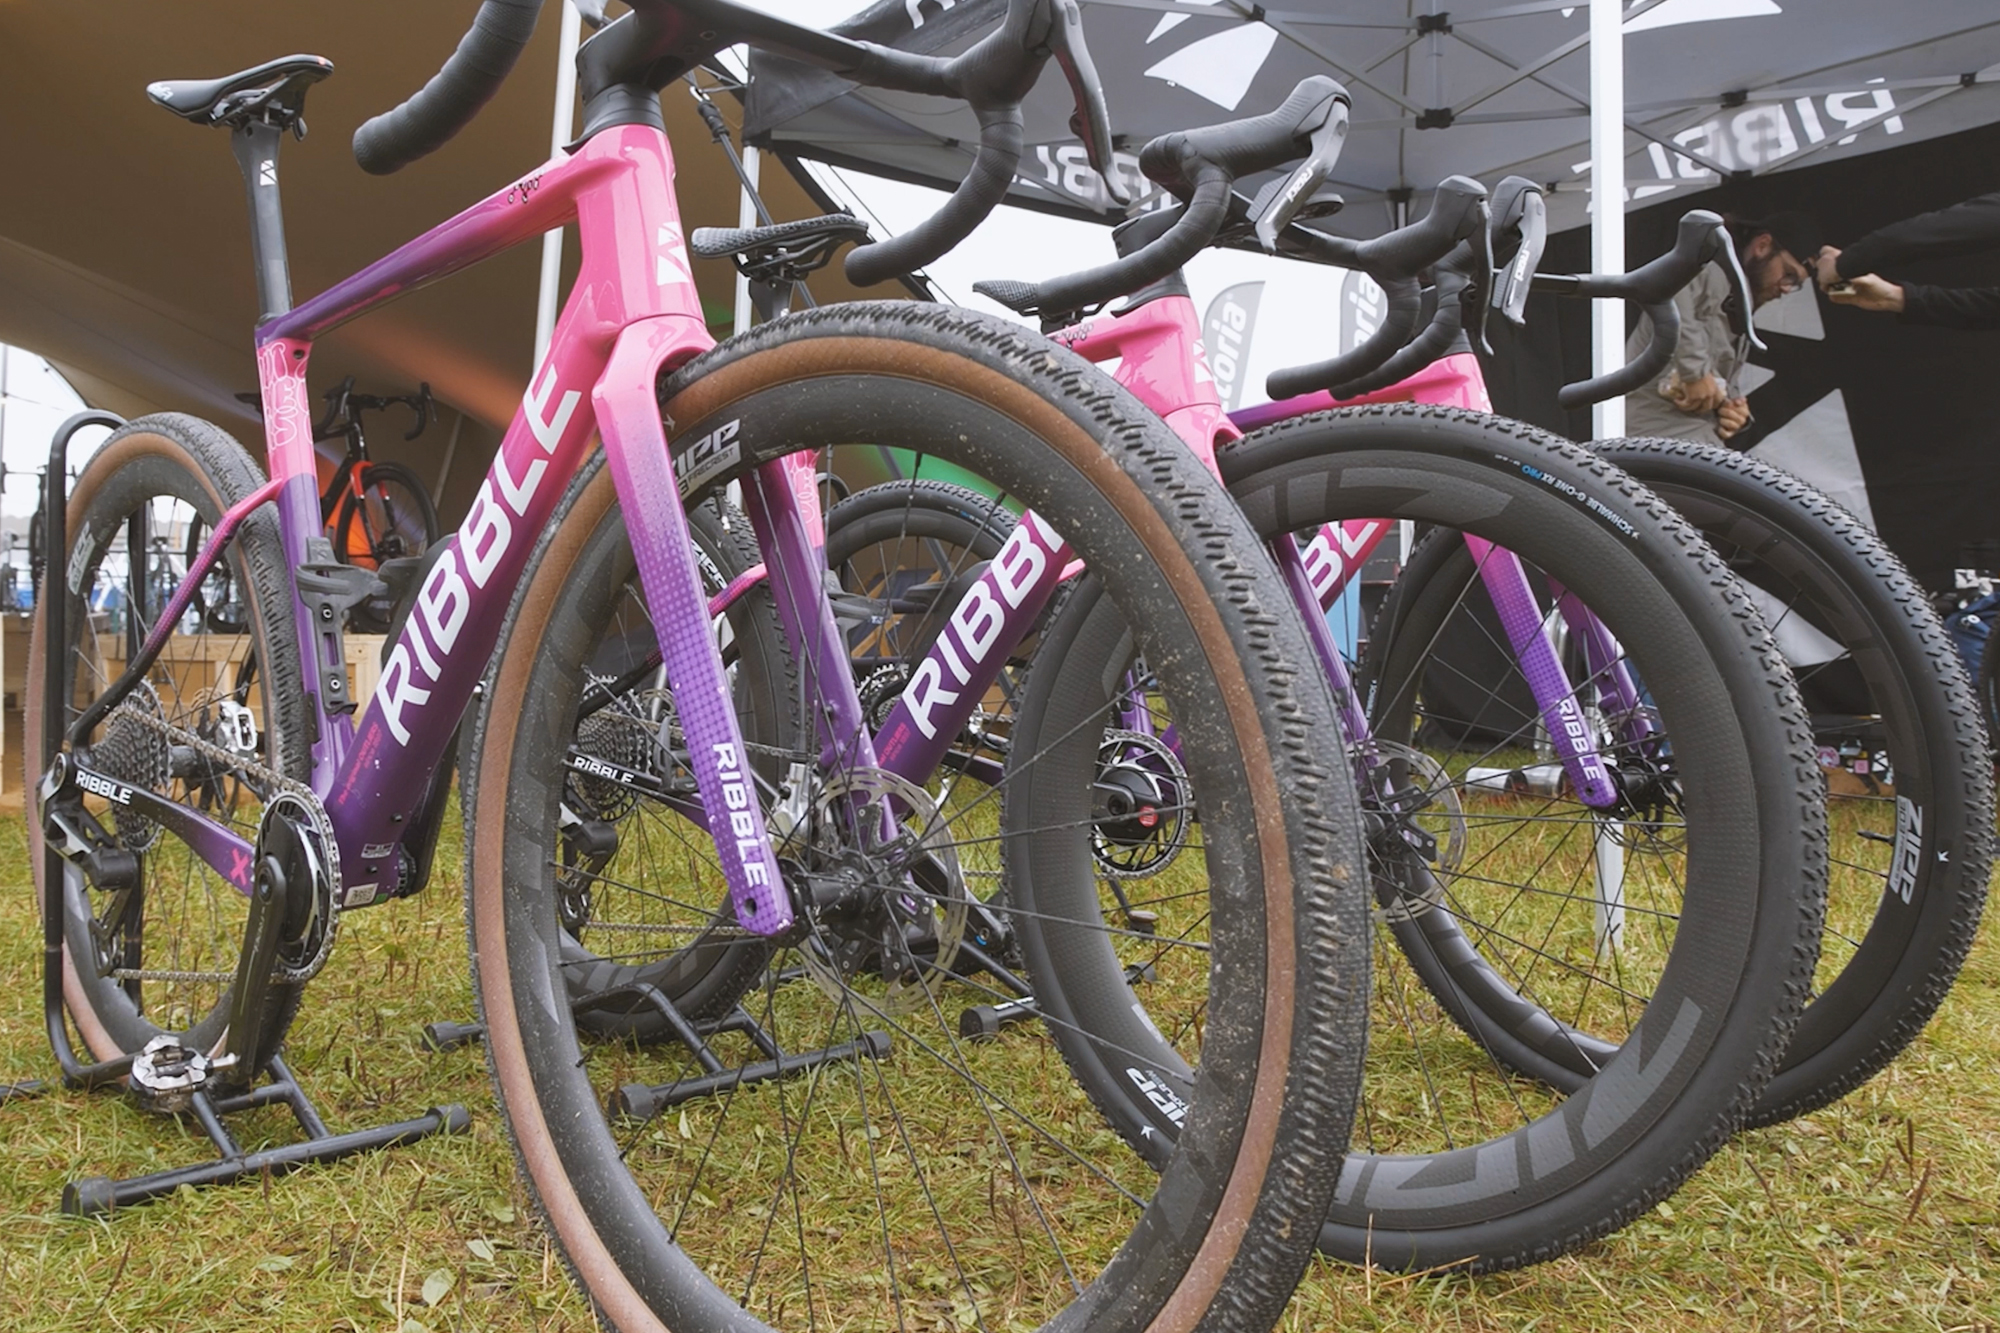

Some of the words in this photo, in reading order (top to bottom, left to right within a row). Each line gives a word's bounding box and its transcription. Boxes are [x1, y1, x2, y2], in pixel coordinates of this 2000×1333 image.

[672, 418, 740, 478] IPP
[1521, 464, 1543, 480] PRO
[1585, 496, 1635, 535] SCHWALBE
[376, 363, 582, 747] RIBBLE
[573, 756, 635, 783] RIBBLE
[1556, 698, 1602, 781] RIBBLE
[75, 769, 133, 805] RIBBLE
[712, 742, 769, 888] RIBBLE
[1901, 801, 1922, 905] ZIPP
[1126, 1067, 1186, 1129] IPP
